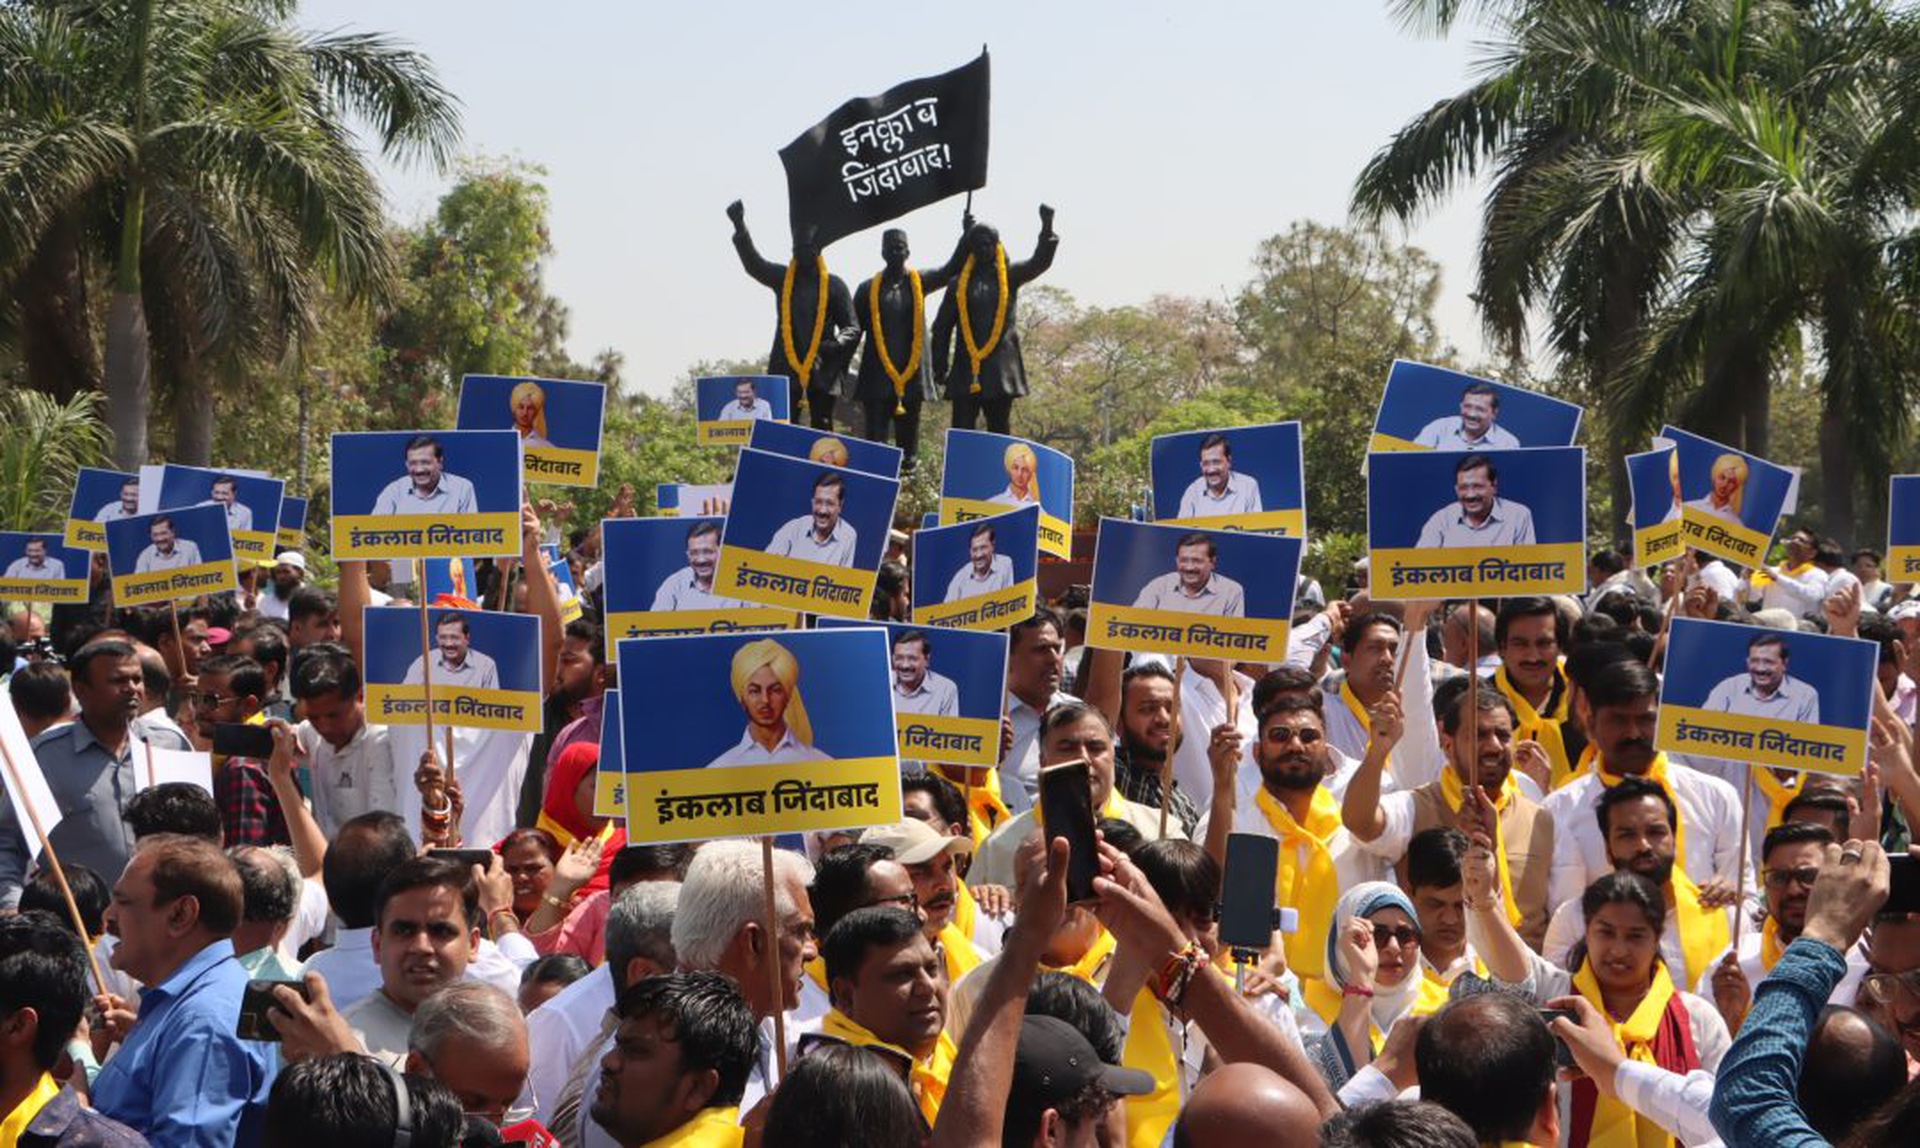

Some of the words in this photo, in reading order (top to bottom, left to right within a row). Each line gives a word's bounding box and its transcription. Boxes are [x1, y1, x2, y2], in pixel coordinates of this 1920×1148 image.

[350, 526, 424, 547] इंकलाब
[426, 524, 504, 545] जिंदाबाद
[1705, 525, 1758, 557] जिंदाबाद
[124, 579, 170, 597] इंकलाब
[171, 571, 224, 591] जिंदाबाद
[736, 562, 811, 597] इंकलाब
[811, 575, 863, 605] जिंदाबाद
[1391, 562, 1475, 587] इंकलाब
[1478, 558, 1565, 583] जिंदाबाद
[980, 595, 1028, 621] जिंदाबाद
[1107, 616, 1183, 642] इंकलाब
[1188, 623, 1270, 650] जिंदाबाद
[454, 696, 524, 720] जिंदाबाद
[905, 724, 984, 753] जिंदाबाद
[1676, 718, 1755, 749] इंकलाब
[1759, 729, 1847, 762] जिंदाबाद
[655, 789, 766, 825] इंकलाब
[772, 779, 879, 814] जिंदाबाद
